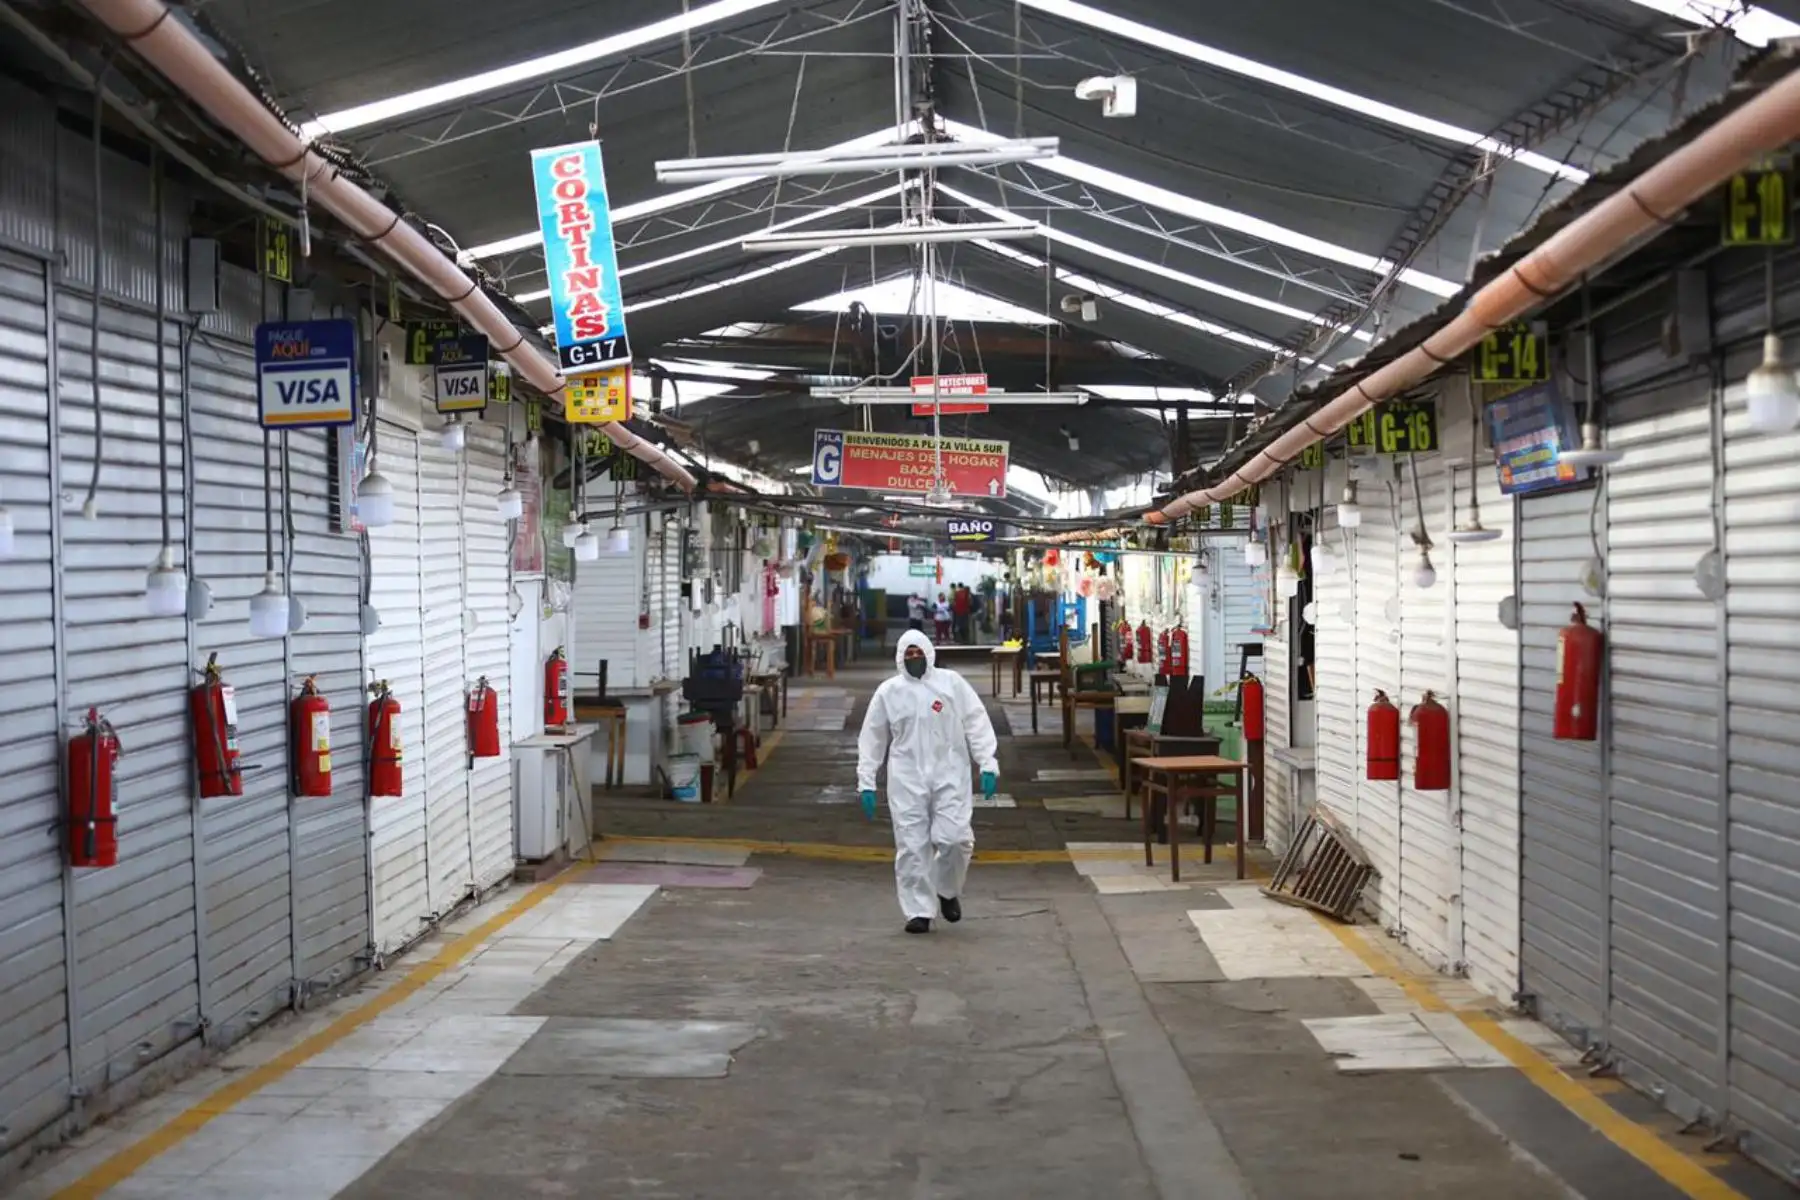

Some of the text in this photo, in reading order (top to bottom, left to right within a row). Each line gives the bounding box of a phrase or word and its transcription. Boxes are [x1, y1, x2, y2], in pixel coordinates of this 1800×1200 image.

[553, 154, 606, 339] CORTINAS
[569, 340, 617, 364] G-17
[1481, 333, 1538, 380] G-14
[272, 377, 340, 405] VISA
[442, 376, 480, 396] VISA
[817, 433, 842, 442] FILA
[1381, 411, 1431, 453] G-16
[849, 448, 915, 463] MENAJES
[948, 454, 999, 468] HOGAR
[911, 439, 919, 448] A
[953, 442, 981, 452] VILLA
[983, 444, 1004, 454] SUR
[816, 444, 840, 482] G
[948, 520, 993, 533] BAÑO
